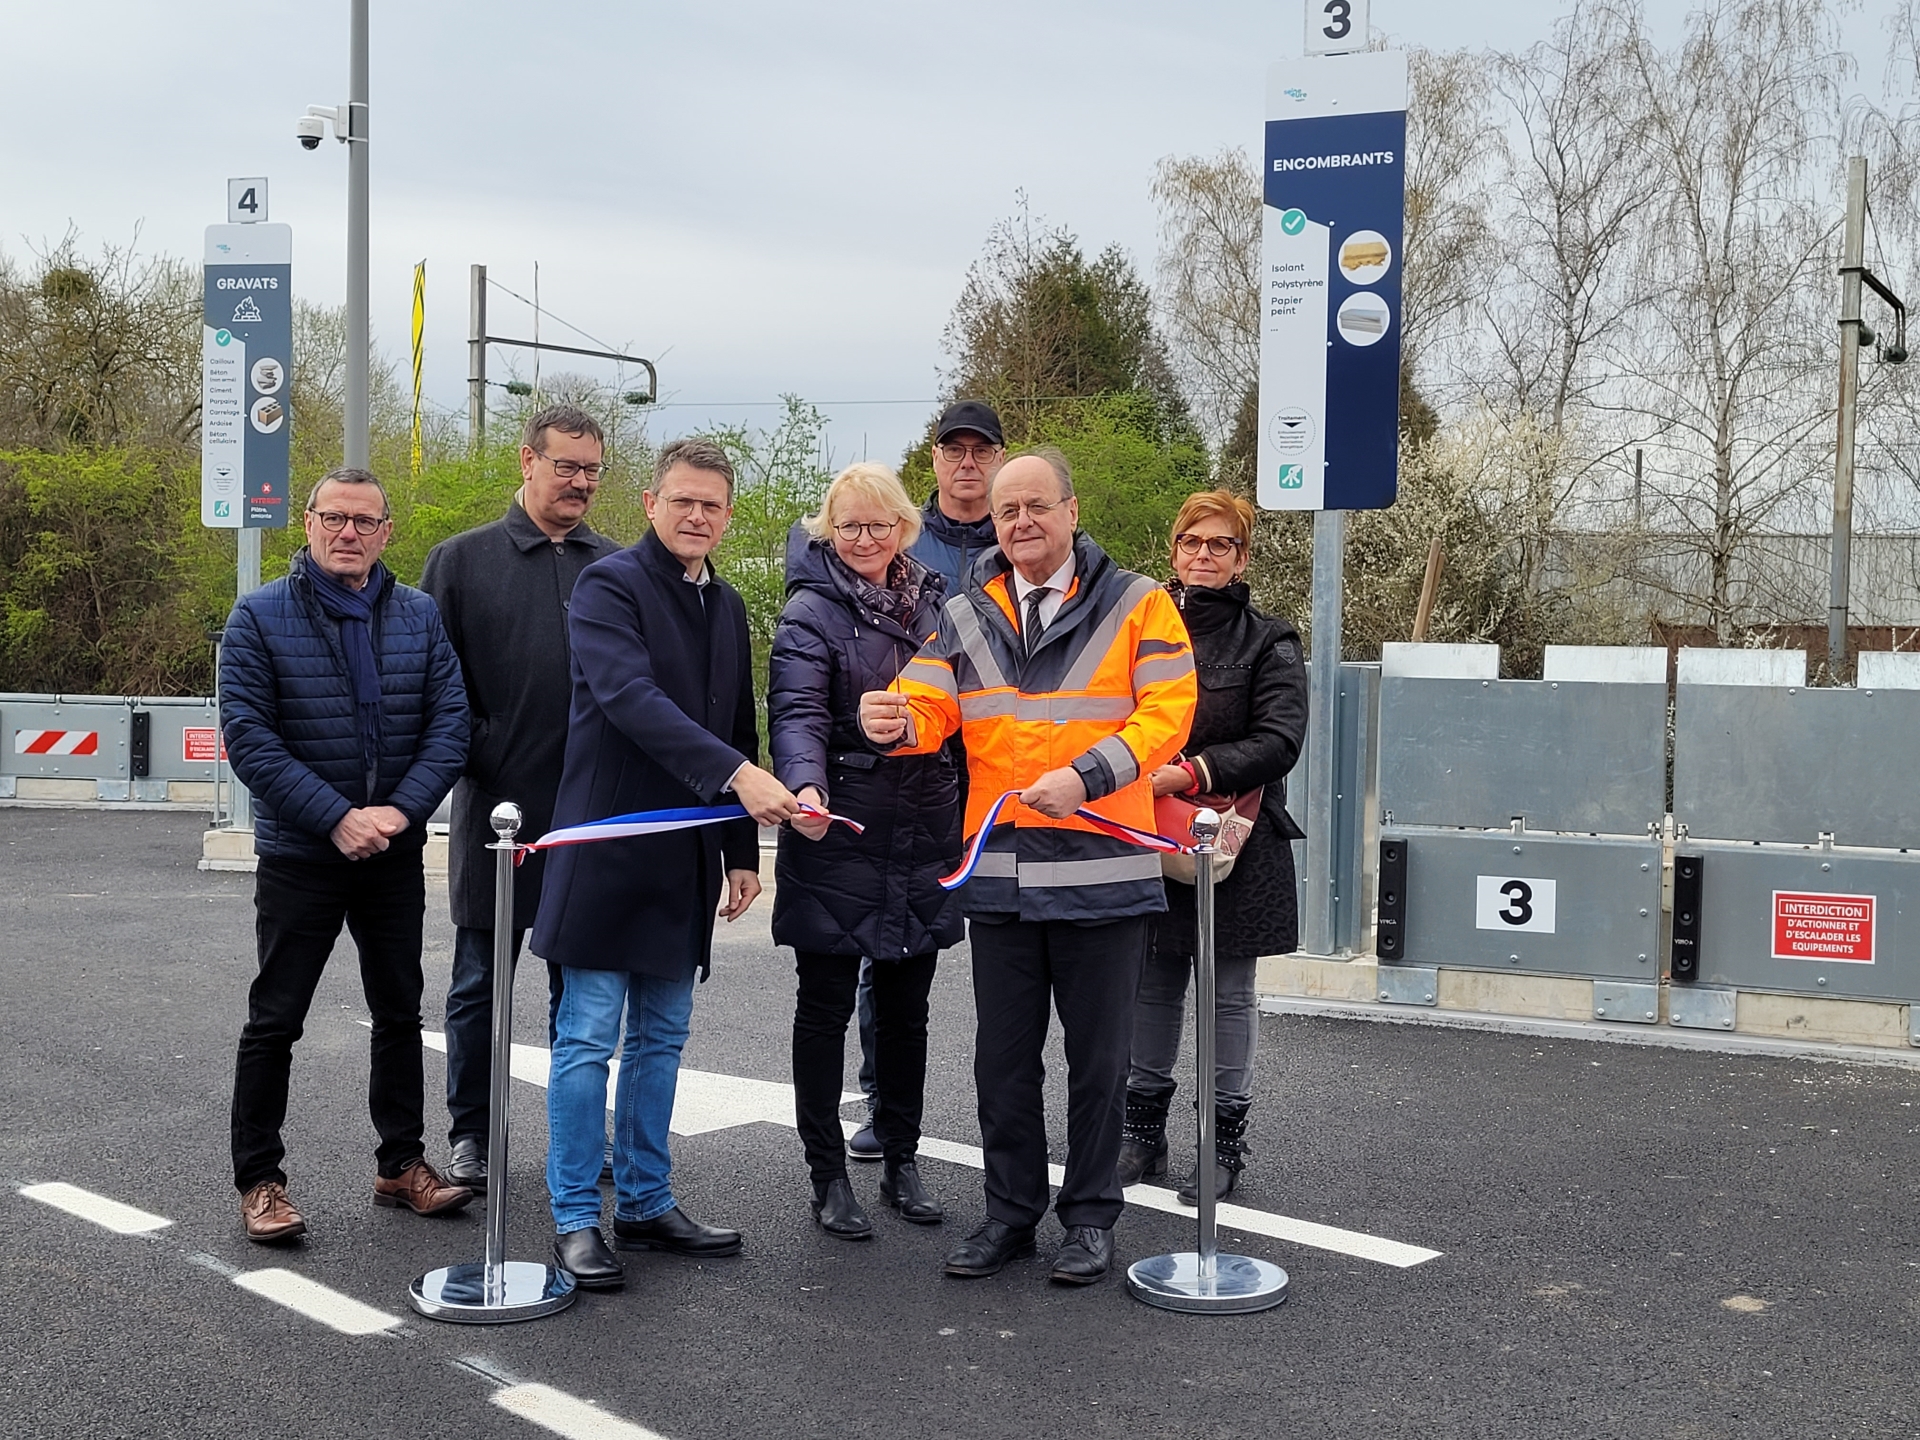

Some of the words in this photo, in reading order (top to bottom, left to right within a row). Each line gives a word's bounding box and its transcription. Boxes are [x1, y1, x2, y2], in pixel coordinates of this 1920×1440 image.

[1323, 0, 1351, 39] 3
[1273, 152, 1394, 172] ENCOMBRANTS
[238, 188, 258, 214] 4
[1272, 263, 1305, 272] Isolant
[216, 278, 278, 290] GRAVATS
[1272, 278, 1324, 290] Polystyrène
[1271, 296, 1303, 306] Papier
[1270, 306, 1296, 316] peint
[1498, 880, 1532, 925] 3
[1785, 903, 1862, 917] INTERDICTION
[1788, 919, 1846, 930] D'ACTIONNER
[1849, 922, 1859, 931] ET
[1786, 930, 1844, 942] D'ESCALADER
[1846, 934, 1861, 943] LES
[1792, 942, 1854, 954] EQUIPEMENTS
